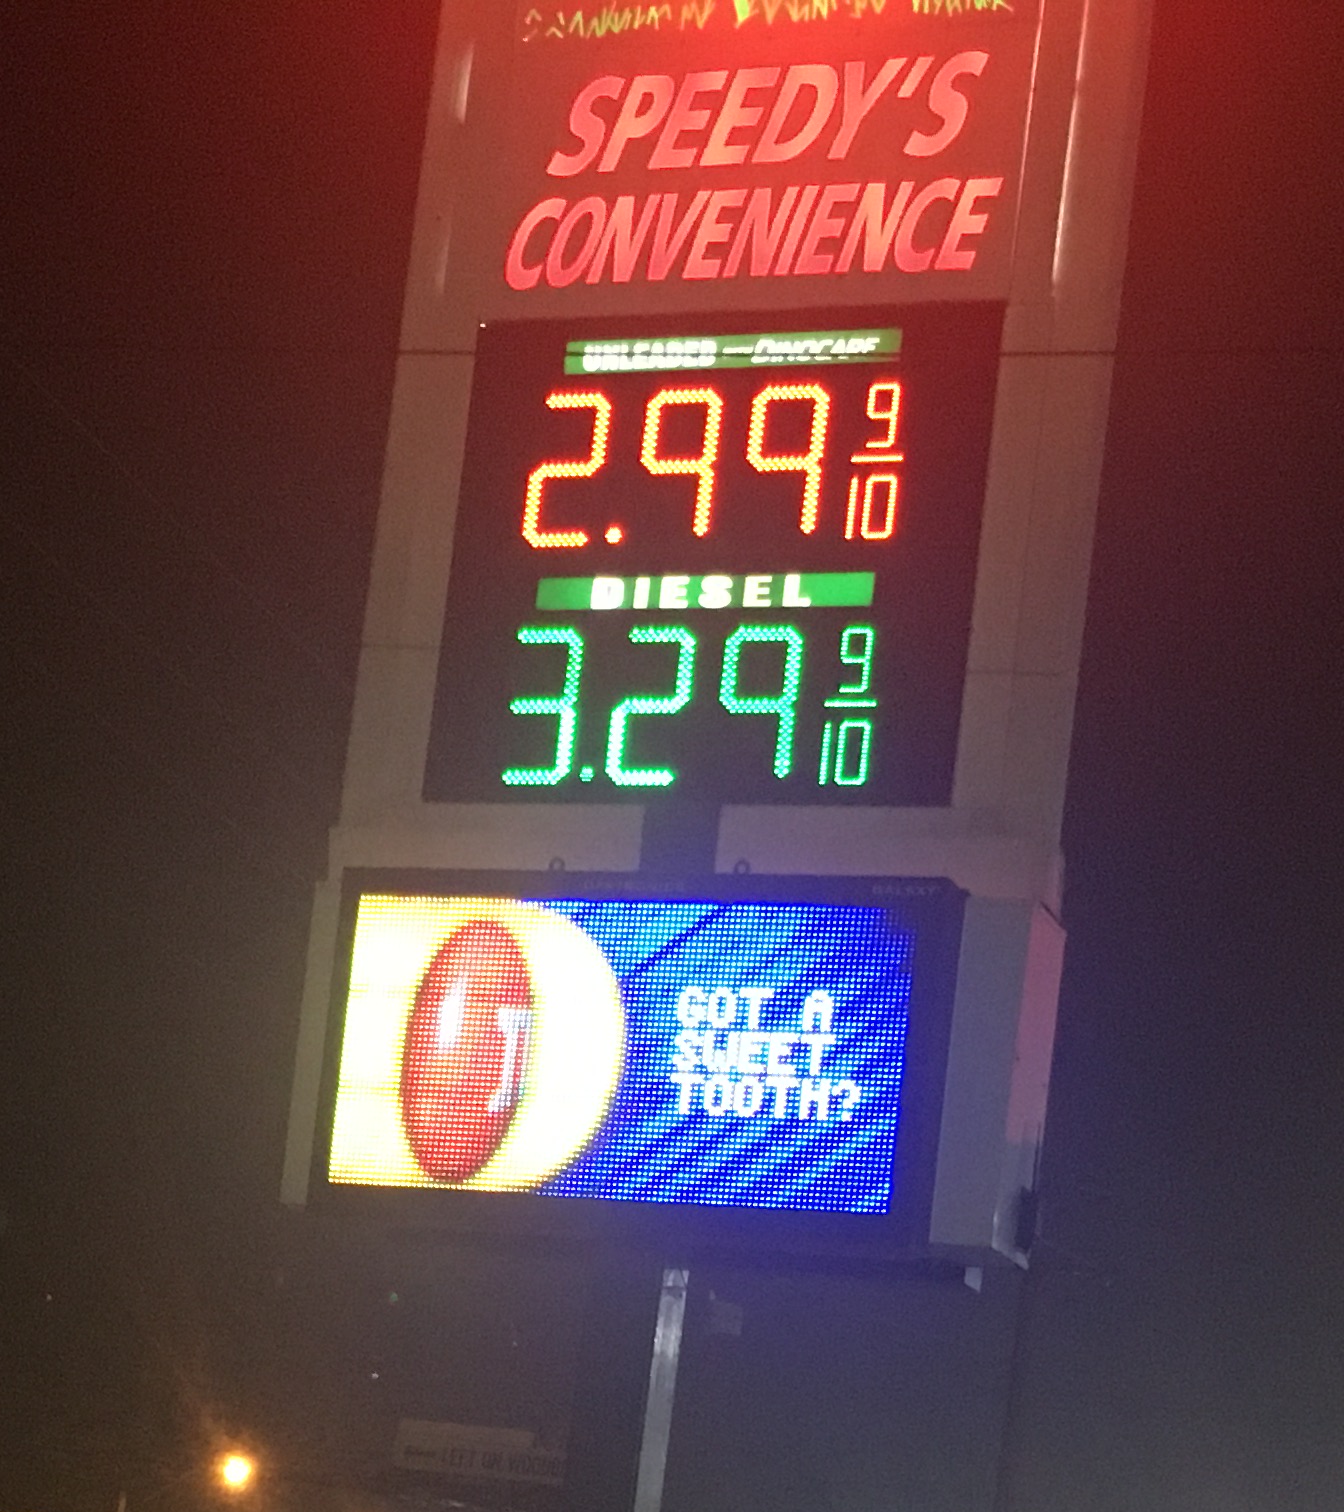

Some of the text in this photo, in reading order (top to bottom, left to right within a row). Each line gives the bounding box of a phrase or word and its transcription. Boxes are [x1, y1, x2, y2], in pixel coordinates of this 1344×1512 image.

[546, 50, 989, 178] SPEEDY'S
[504, 176, 1004, 290] CONVENIENCE
[582, 338, 717, 372] UNLEADED
[521, 384, 831, 549] 2.99
[588, 573, 812, 611] DIESEL
[501, 625, 804, 787] 3.29
[676, 985, 835, 1032] GOT A
[672, 1029, 837, 1078] SWEET
[669, 1072, 862, 1123] TOOTH?
